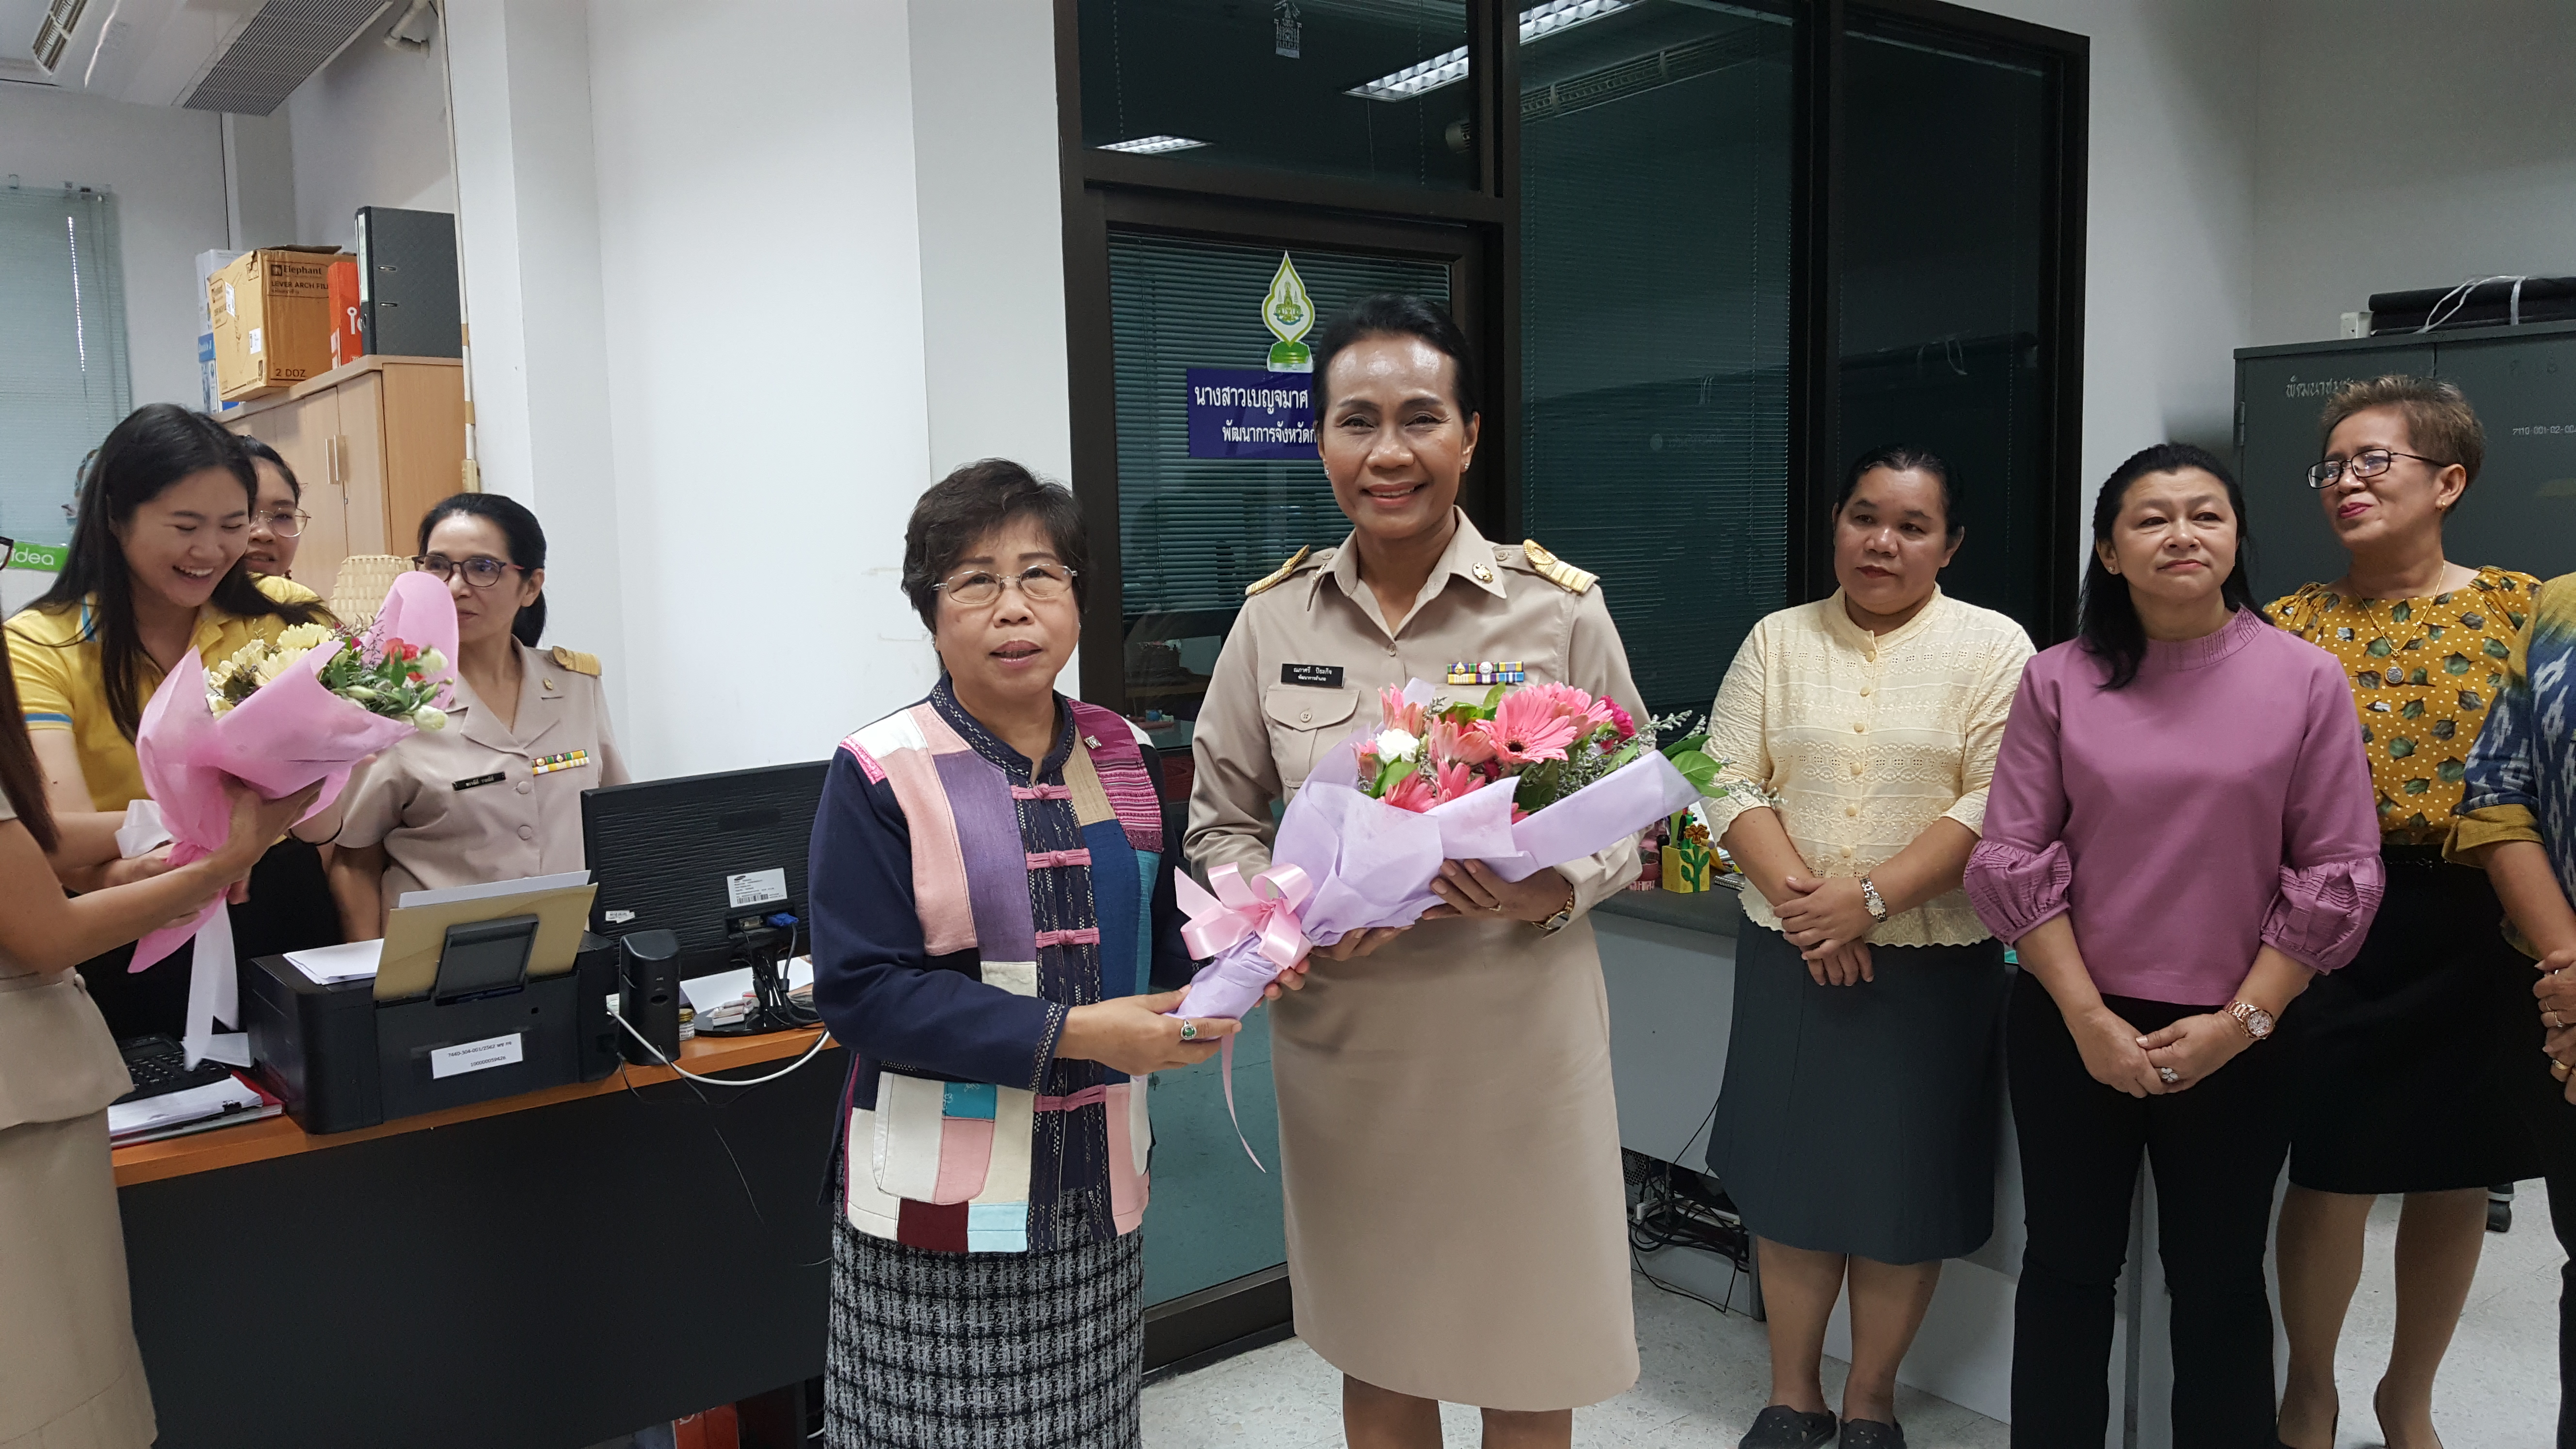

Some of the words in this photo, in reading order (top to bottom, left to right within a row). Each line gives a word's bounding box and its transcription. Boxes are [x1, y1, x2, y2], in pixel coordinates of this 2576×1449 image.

[283, 265, 322, 275] Elephant
[275, 368, 281, 377] 2
[285, 369, 307, 377] DOZ
[1194, 386, 1308, 415] นางสาวเบญจมาศ
[2512, 424, 2576, 435] 7110-001-02-00
[11, 547, 54, 565] idea
